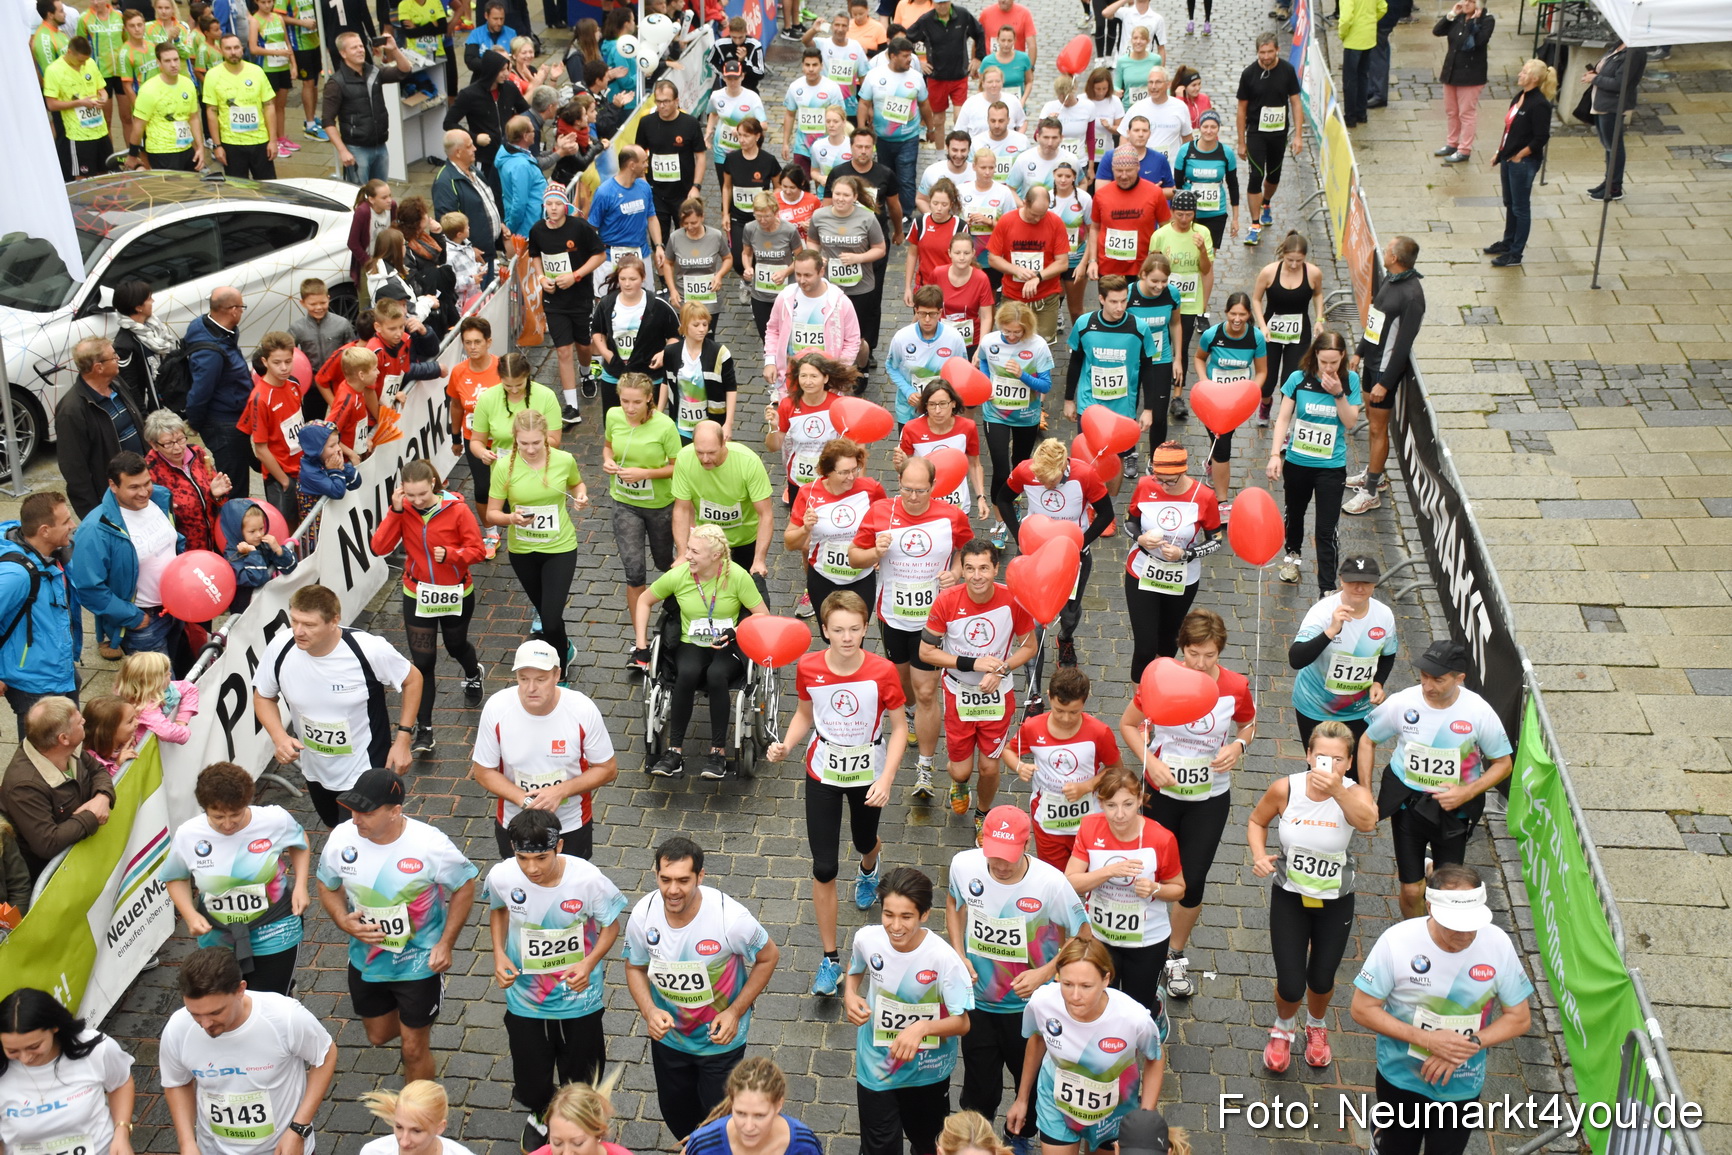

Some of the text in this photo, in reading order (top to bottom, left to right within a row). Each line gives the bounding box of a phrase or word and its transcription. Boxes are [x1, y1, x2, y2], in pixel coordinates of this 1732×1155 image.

[831, 64, 853, 76] 5246
[885, 102, 909, 116] 5247
[232, 112, 258, 124] 2905
[800, 113, 823, 125] 5212
[654, 160, 678, 172] 5115
[820, 235, 863, 245] LEHMEIER
[1108, 237, 1135, 250] 5215
[543, 260, 567, 272] 5027
[678, 256, 714, 266] LEHMEIER
[831, 264, 859, 277] 5063
[1269, 320, 1300, 334] 5270
[794, 330, 824, 345] 5125
[1092, 346, 1127, 358] HUBER
[1094, 374, 1124, 388] 5157
[995, 384, 1027, 399] 5070
[1305, 402, 1337, 414] HUBER
[1297, 427, 1333, 446] 5118
[704, 507, 739, 521] 5099
[524, 530, 549, 539] Theresa
[830, 566, 857, 577] Christina
[1146, 564, 1183, 583] 5055
[1150, 580, 1174, 590] Carmen
[420, 590, 459, 604] 5086
[895, 590, 933, 607] 5198
[426, 605, 452, 613] Vanessa
[902, 608, 927, 616] Andreas
[1333, 663, 1373, 681] 5124
[1336, 681, 1364, 691] Manuela
[961, 690, 1001, 706] 5059
[965, 706, 996, 716] Johannes
[1452, 720, 1473, 734] Hervis
[304, 725, 347, 746] 5273
[316, 744, 335, 754] Erich
[828, 753, 870, 772] 5173
[1409, 754, 1455, 776] 5123
[836, 773, 860, 782] Tilman
[1180, 787, 1193, 796] Eva
[1047, 800, 1090, 819] 5060
[1303, 819, 1340, 829] KLEBL
[992, 829, 1015, 841] DEKRA
[1292, 853, 1342, 878] 5308
[1018, 900, 1040, 910] Hervis
[1093, 907, 1140, 931] 5120
[974, 919, 1021, 946] 5225
[528, 936, 580, 957] 5226
[698, 941, 720, 952] Hervis
[977, 943, 1016, 957] Chodadad
[542, 957, 566, 968] Javad
[1471, 967, 1495, 979] Hervis
[654, 972, 705, 991] 5229
[1101, 1040, 1125, 1050] Hervis
[1060, 1081, 1112, 1110] 5151
[210, 1103, 267, 1126] 5143
[1068, 1106, 1104, 1119] Susanne
[223, 1127, 256, 1139] Tassilo
